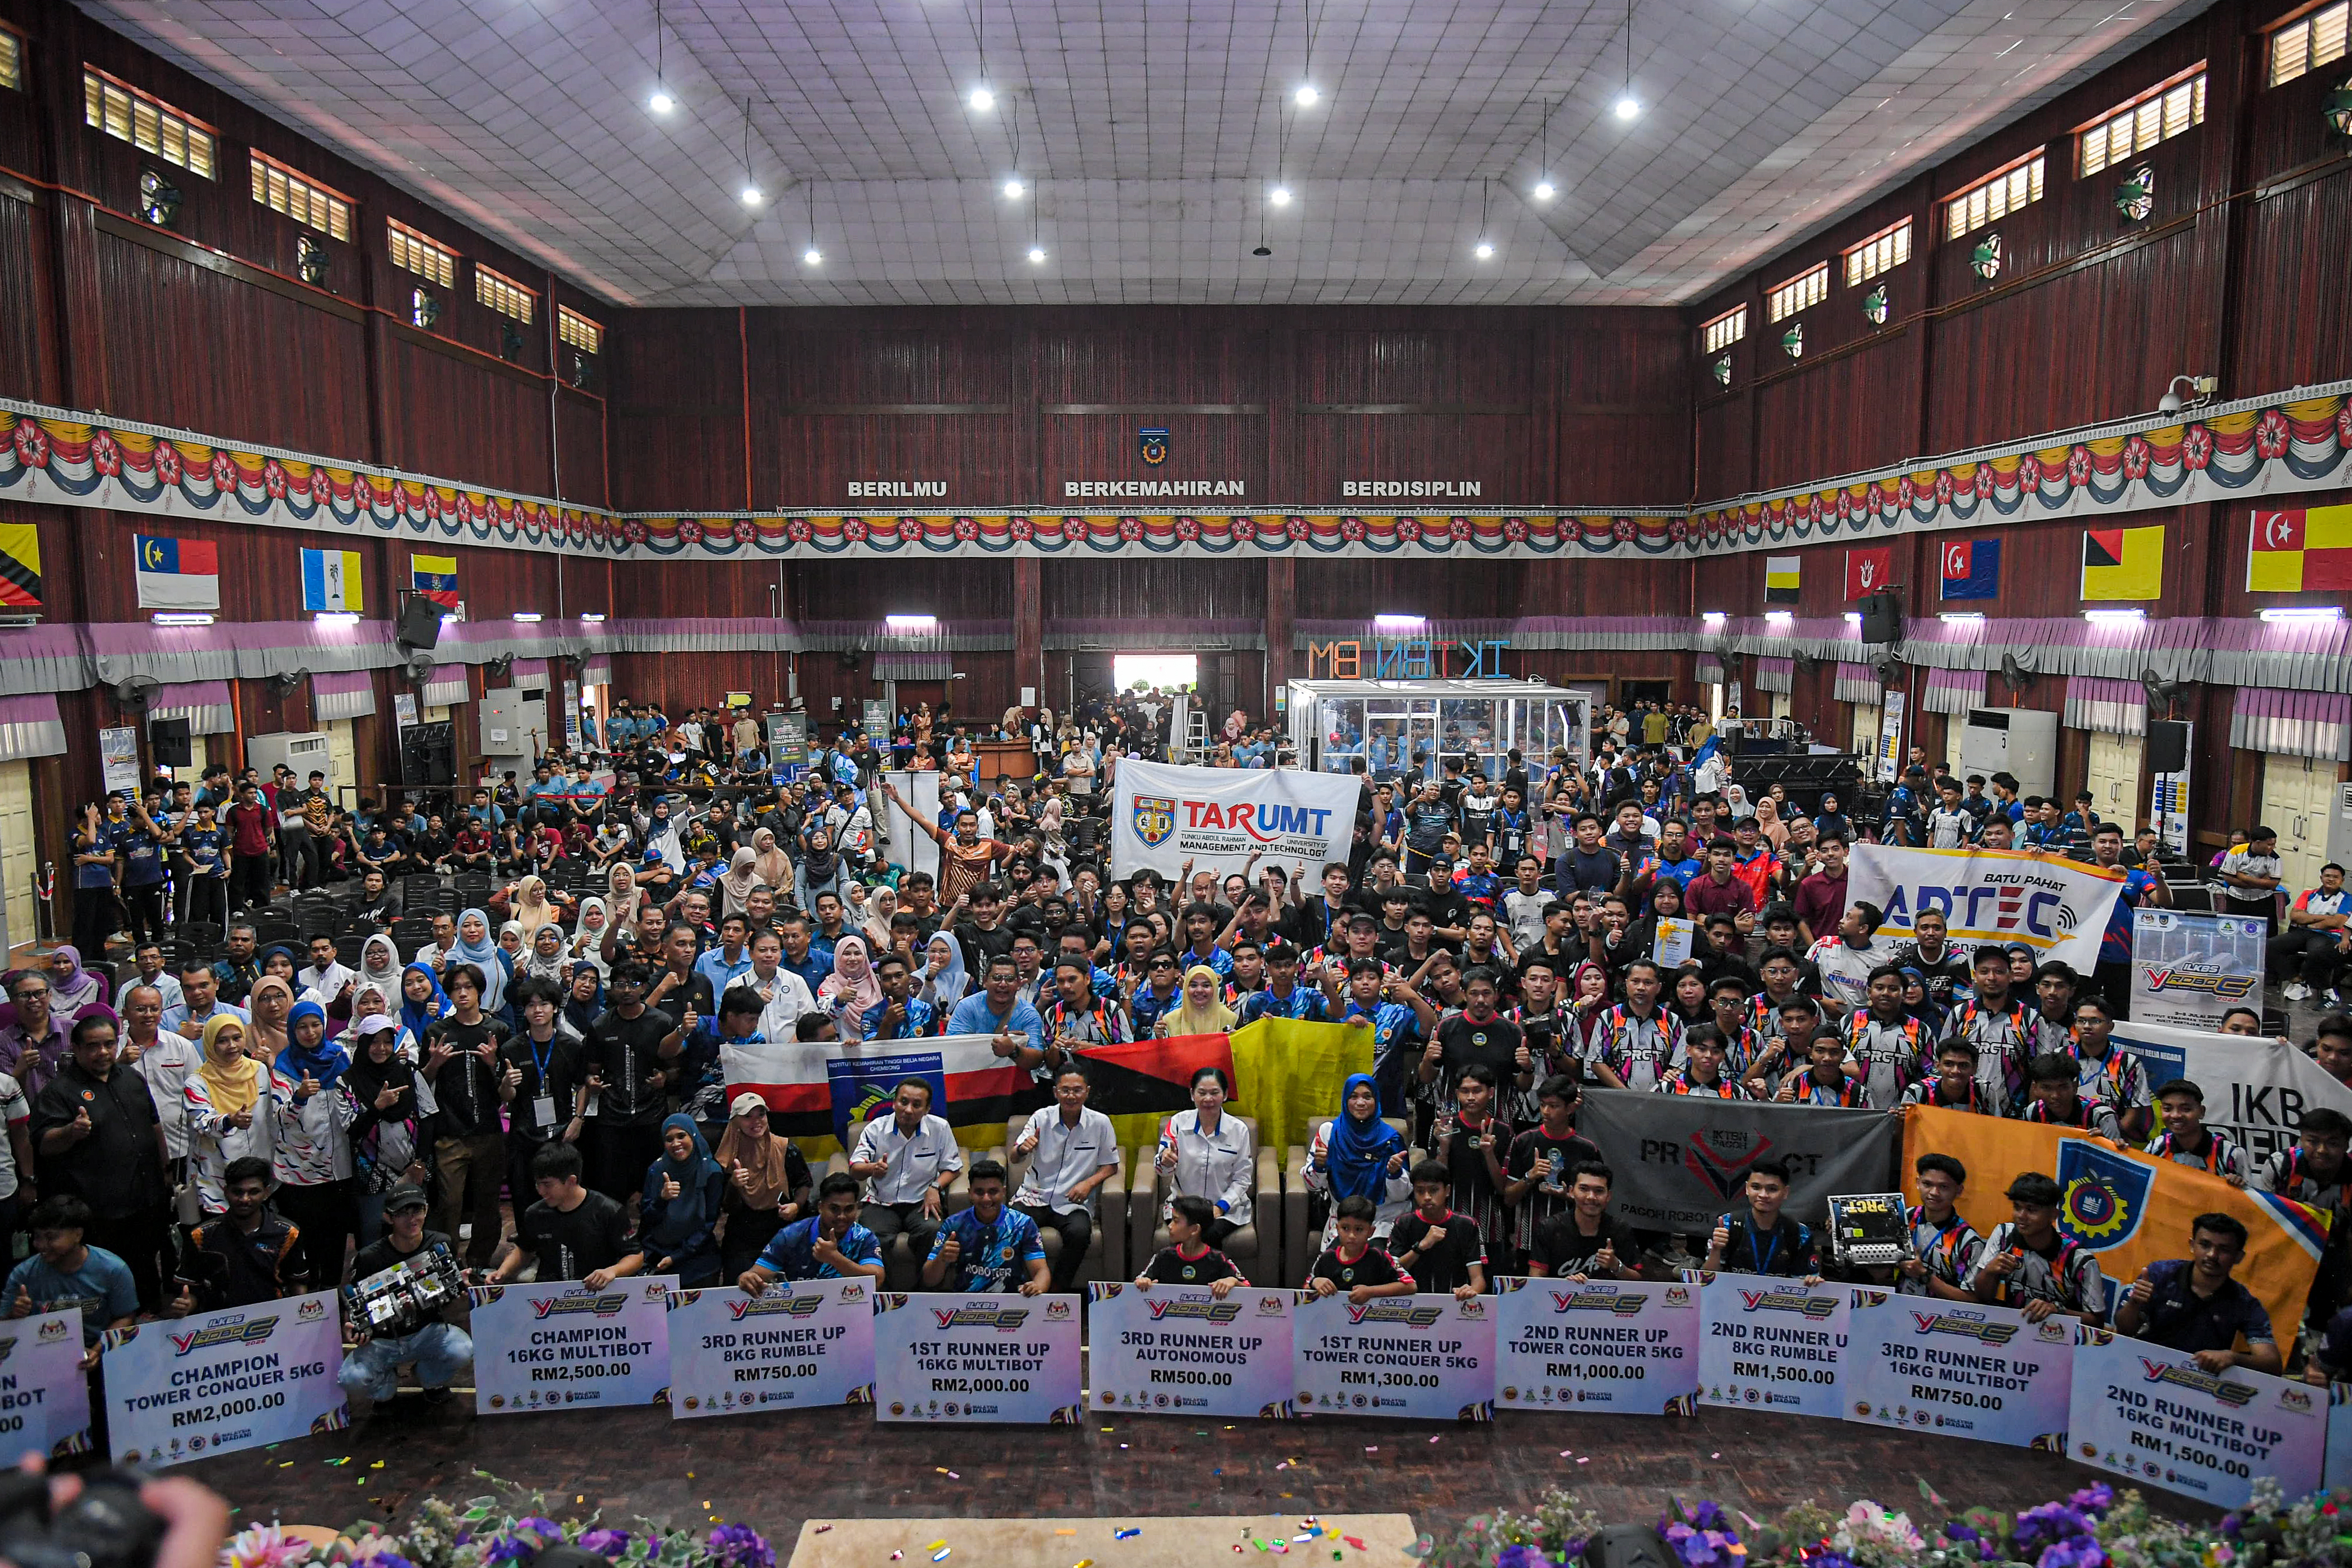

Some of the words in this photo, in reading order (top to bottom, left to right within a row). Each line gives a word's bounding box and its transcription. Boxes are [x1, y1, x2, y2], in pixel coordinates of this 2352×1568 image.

[848, 482, 947, 497] BERILMU
[1065, 481, 1244, 497] BERKEMAHIRAN
[1343, 481, 1481, 497] BERDISIPLIN
[1179, 841, 1247, 852] MANAGEMENT
[1248, 843, 1267, 852] AND
[1269, 844, 1328, 857] TECHNOLOGY
[1286, 839, 1320, 848] UNIVERSITY
[1984, 873, 2021, 884] BATU
[2023, 875, 2066, 892] PAHAT
[1882, 885, 2061, 938] ADTEC
[2183, 963, 2220, 973] ILKBS
[1179, 1293, 1211, 1302] ILKBS
[1585, 1285, 1618, 1294] ILKBS
[1774, 1285, 1808, 1295] ILKBS
[1379, 1299, 1412, 1307] ILKBS
[207, 1314, 244, 1328] ILKBS
[531, 1326, 627, 1346] CHAMPION
[702, 1333, 737, 1349] 3RD
[742, 1328, 818, 1347] RUNNER
[822, 1325, 847, 1342] UP
[1121, 1331, 1155, 1346] 3RD
[1160, 1333, 1235, 1349] RUNNER
[1239, 1336, 1263, 1351] UP
[1524, 1325, 1560, 1341] 2ND
[1565, 1327, 1639, 1343] RUNNER
[1645, 1329, 1669, 1343] UP
[1712, 1322, 1748, 1338] 2ND
[1753, 1326, 1821, 1346] RUNNER
[507, 1347, 555, 1363] 16KG
[560, 1341, 652, 1361] MULTIBOT
[724, 1348, 758, 1362] 8KG
[761, 1343, 826, 1360] RUMBLE
[910, 1342, 947, 1356] 1ST
[951, 1342, 1021, 1356] RUNNER
[1025, 1343, 1050, 1357] UP
[1320, 1335, 1352, 1350] 1ST
[1358, 1337, 1431, 1352] RUNNER
[1438, 1339, 1462, 1353] UP
[1509, 1341, 1563, 1355] TOWER
[1569, 1343, 1647, 1358] CONQUER
[1651, 1346, 1683, 1360] 5KG
[1732, 1341, 1765, 1354] 8KG
[1770, 1344, 1837, 1363] RUMBLE
[917, 1358, 959, 1371] 16KG
[962, 1358, 1043, 1372] MULTIBOT
[1136, 1349, 1246, 1365] AUTONOMOUS
[1303, 1350, 1358, 1364] TOWER
[1364, 1352, 1441, 1367] CONQUER
[1446, 1356, 1478, 1369] 5KG
[1881, 1342, 1918, 1360] 3RD
[1925, 1348, 2007, 1373] RUNNER
[2014, 1362, 2039, 1377] UP
[170, 1353, 280, 1387] CHAMPION
[532, 1362, 631, 1382] RM2,500.00
[734, 1362, 818, 1382] RM750.00
[1150, 1369, 1232, 1387] RM500.00
[1340, 1370, 1439, 1388] RM1,300.00
[1546, 1362, 1645, 1380] RM1,000.00
[1733, 1361, 1835, 1384] RM1,500.00
[1890, 1361, 1934, 1379] 16KG
[1939, 1365, 2029, 1392] MULTIBOT
[124, 1390, 192, 1413] TOWER
[195, 1369, 286, 1398] CONQUER
[290, 1361, 326, 1380] 5KG
[932, 1378, 1030, 1394] RM2,000.00
[1910, 1384, 2002, 1411] RM750.00
[172, 1392, 286, 1428] RM2,000.00
[2108, 1384, 2148, 1407] 2ND
[2154, 1398, 2244, 1437] RUNNER
[2252, 1426, 2282, 1446] UP
[2117, 1406, 2164, 1429] 16KG
[2170, 1420, 2270, 1460] MULTIBOT
[2130, 1430, 2250, 1478] RM1,500.00
